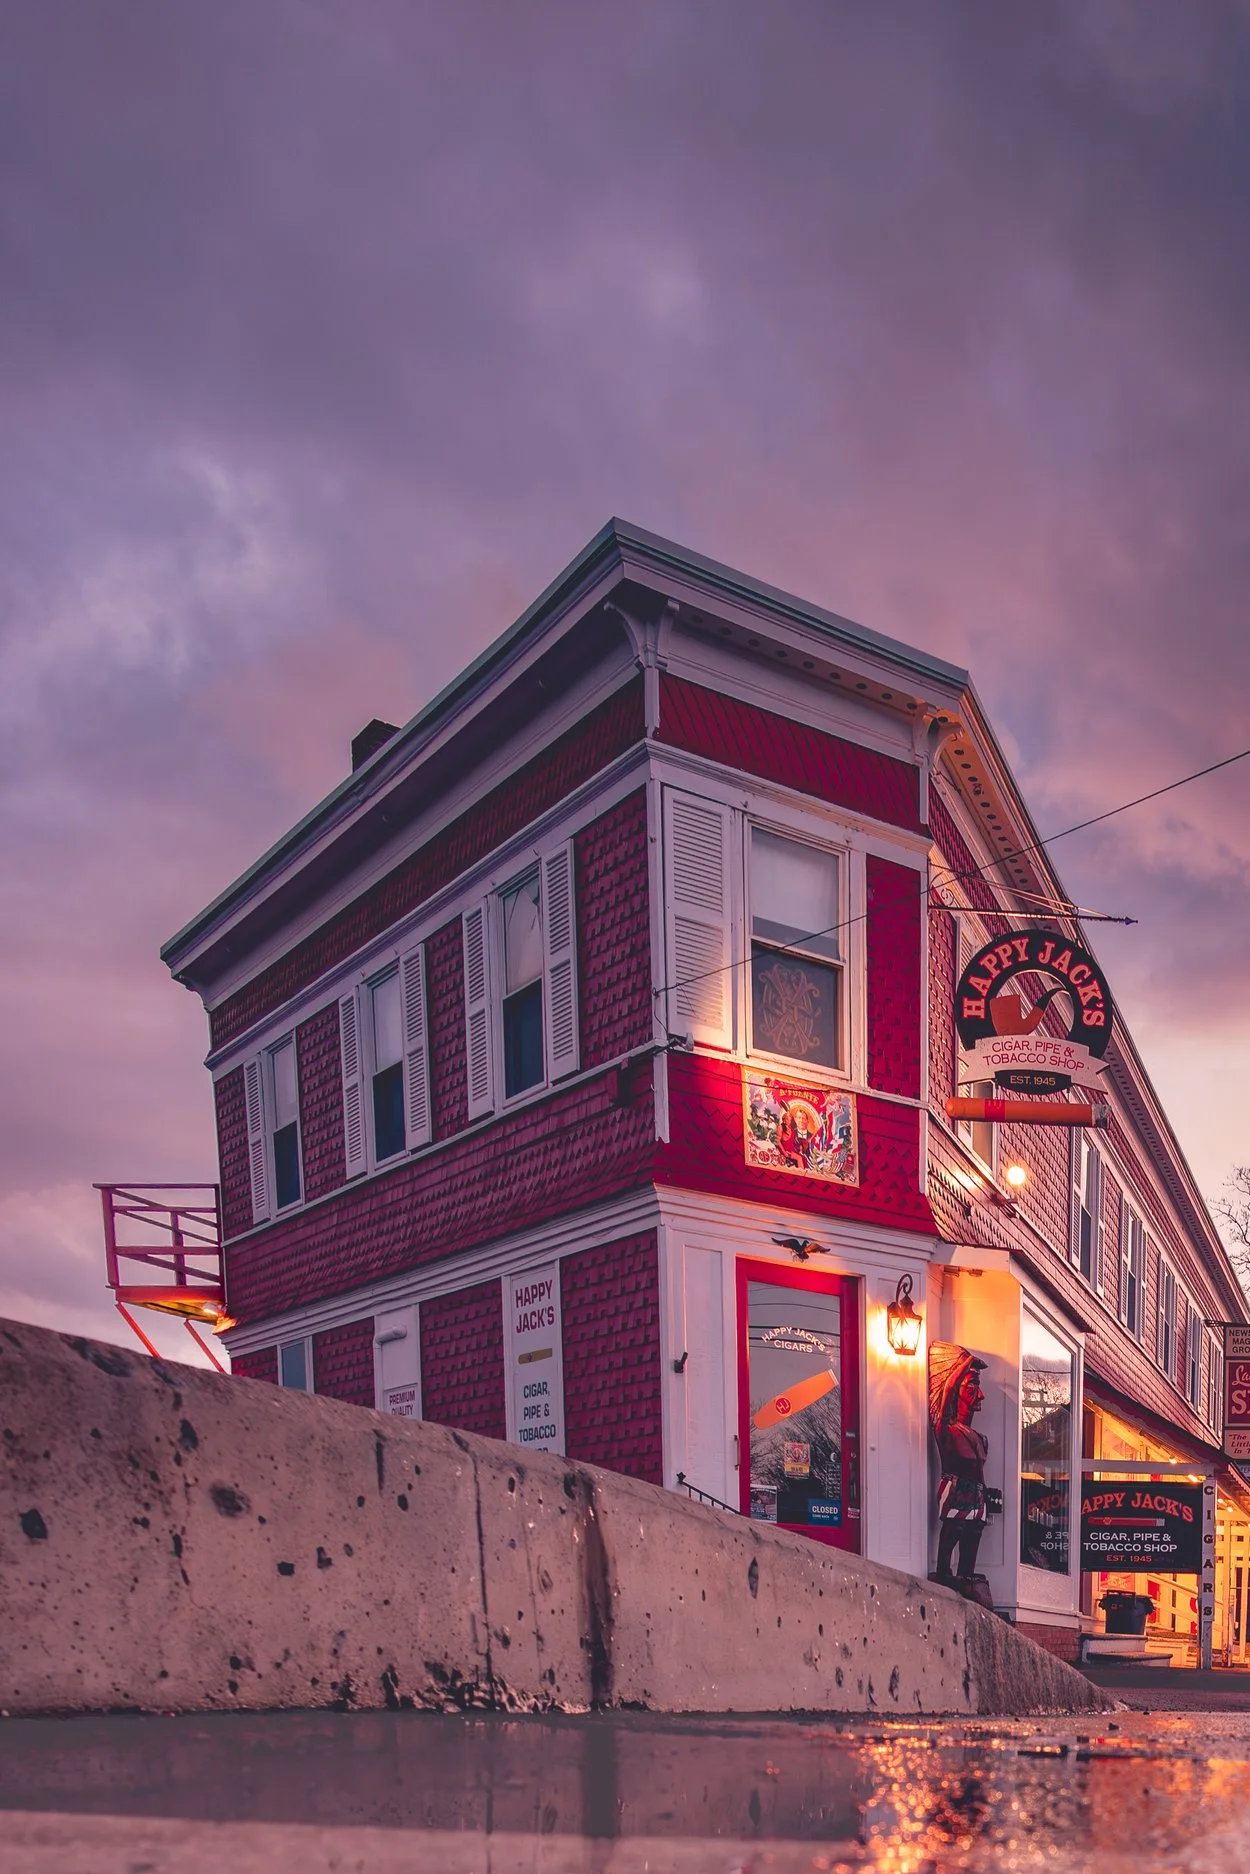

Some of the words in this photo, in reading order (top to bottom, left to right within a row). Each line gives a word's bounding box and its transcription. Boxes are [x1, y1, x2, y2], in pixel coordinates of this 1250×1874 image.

[962, 936, 1030, 1020] HAPPY
[1038, 941, 1106, 1027] JACK'S
[991, 1040, 1032, 1053] CIGAR,
[1035, 1041, 1061, 1053] PIPE
[1064, 1046, 1075, 1058] &
[983, 1053, 1046, 1066] TOBACCO
[1050, 1056, 1085, 1071] SHOP
[1010, 1075, 1031, 1085] EST.
[1034, 1076, 1056, 1086] 1945
[515, 1280, 552, 1308] HAPPY
[516, 1306, 554, 1333] JACK'S
[762, 1326, 793, 1343] HAPPY
[794, 1328, 826, 1352] JACK'S
[773, 1340, 813, 1353] CIGARS
[389, 1390, 416, 1406] PREMIUM
[523, 1381, 550, 1398] CIGAR,
[523, 1405, 541, 1420] PIPE
[543, 1403, 550, 1417] &
[519, 1424, 556, 1442] TOBACCO
[812, 1505, 838, 1514] CLOSED
[1081, 1492, 1126, 1515] APPY
[1131, 1492, 1194, 1522] JACK'S
[1090, 1532, 1130, 1541] CIGAR,
[1133, 1533, 1160, 1541] PIPE
[1162, 1533, 1171, 1542] &
[1083, 1543, 1141, 1551] TOBACCO
[1144, 1544, 1177, 1552] SHOP
[1203, 1486, 1214, 1616] CIGARS
